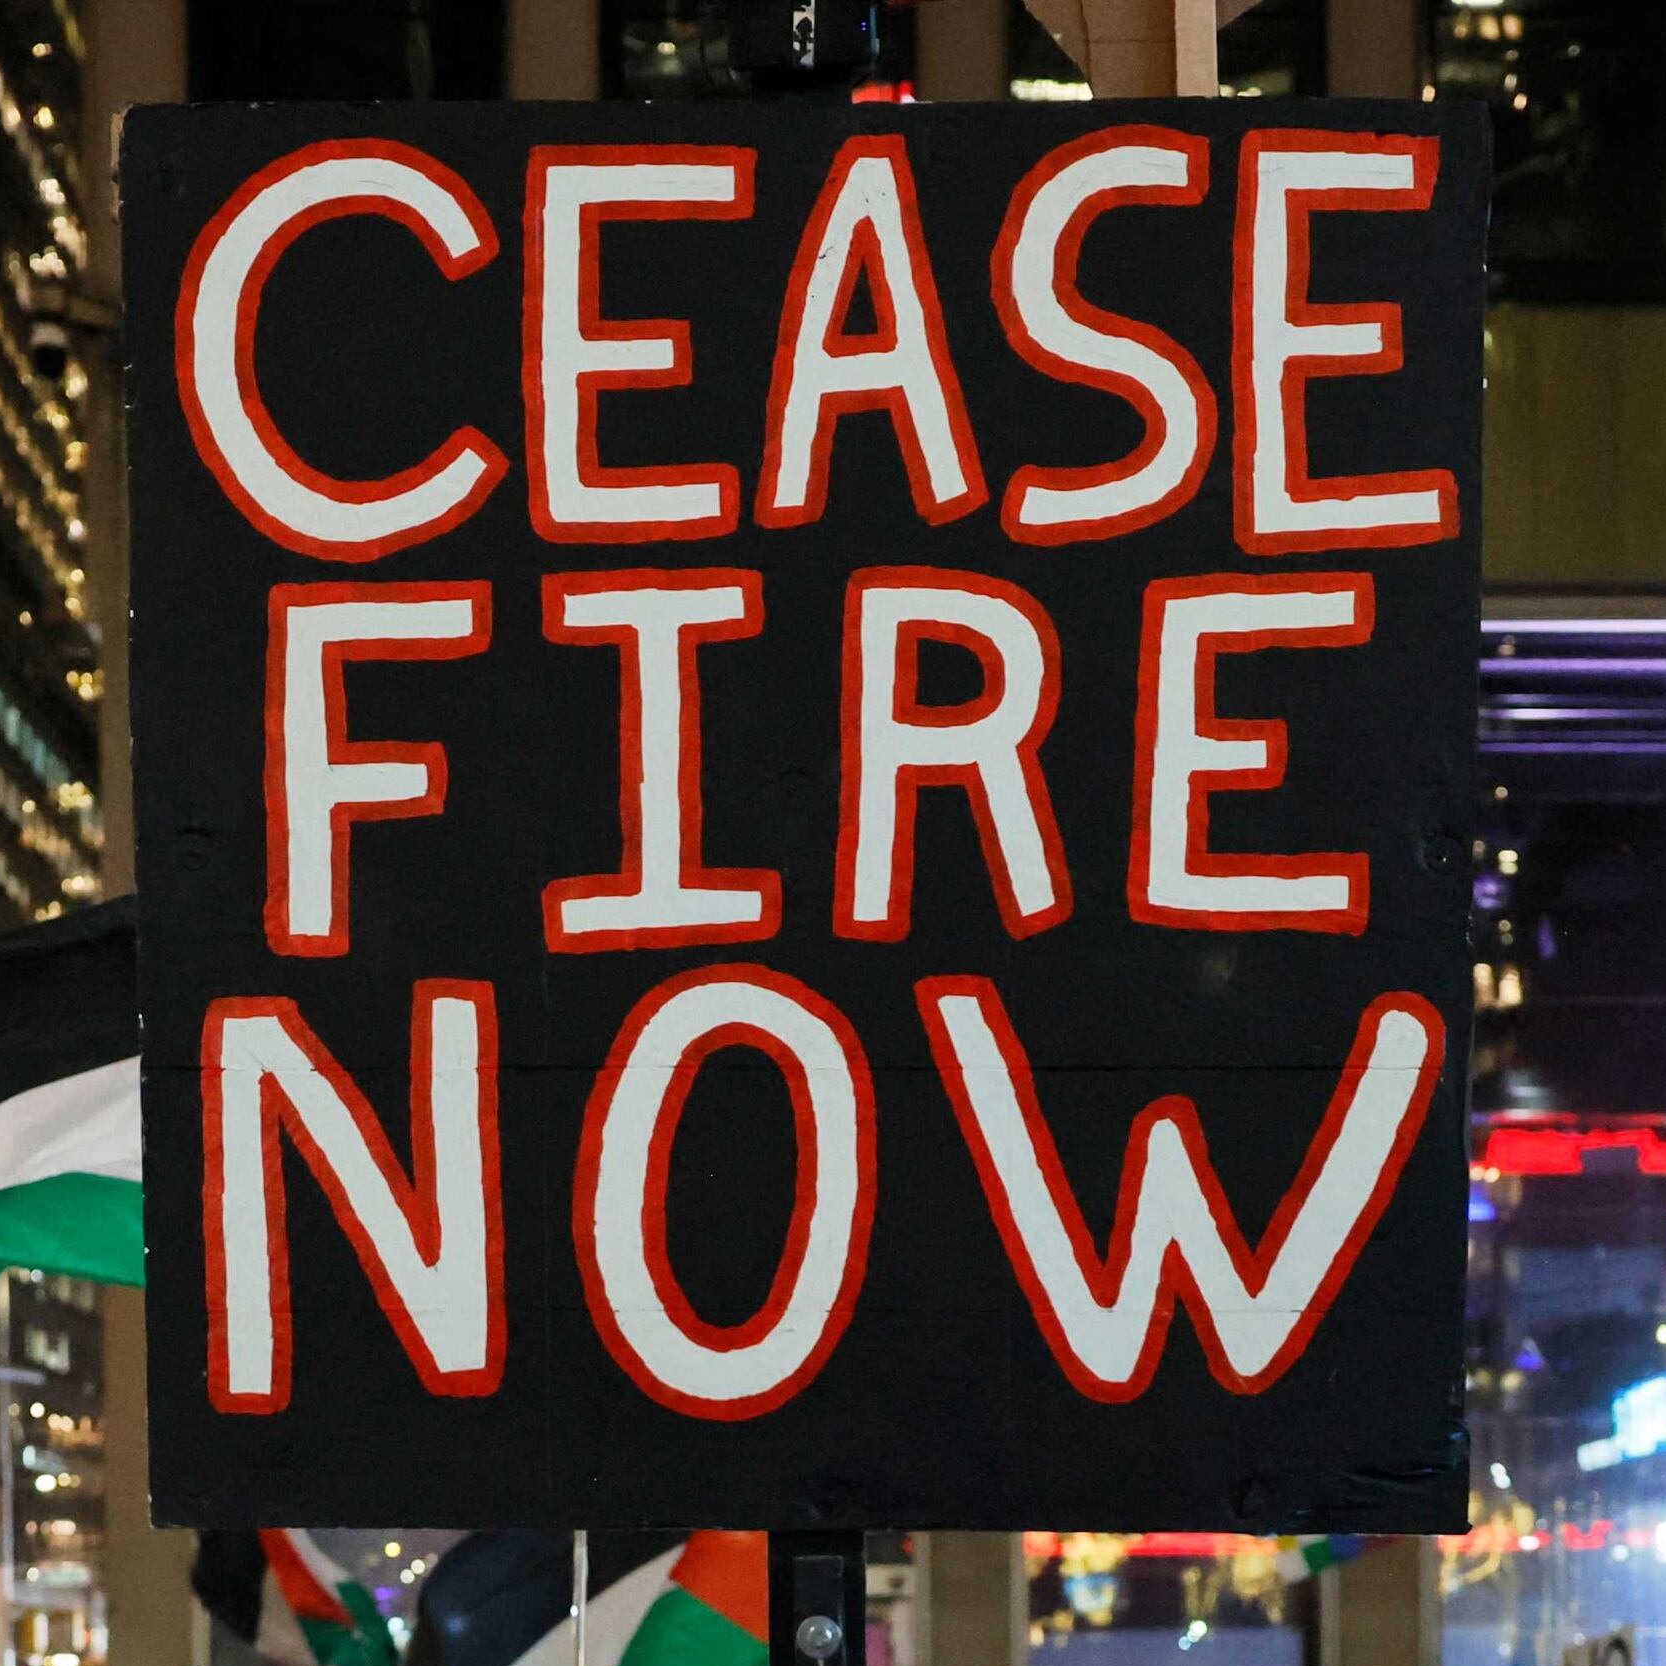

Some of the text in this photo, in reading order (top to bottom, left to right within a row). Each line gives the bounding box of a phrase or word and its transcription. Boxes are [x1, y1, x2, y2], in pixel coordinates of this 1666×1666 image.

[175, 125, 1460, 561] CEASE
[264, 567, 1375, 956] FIRE
[200, 964, 1446, 1421] NOW
